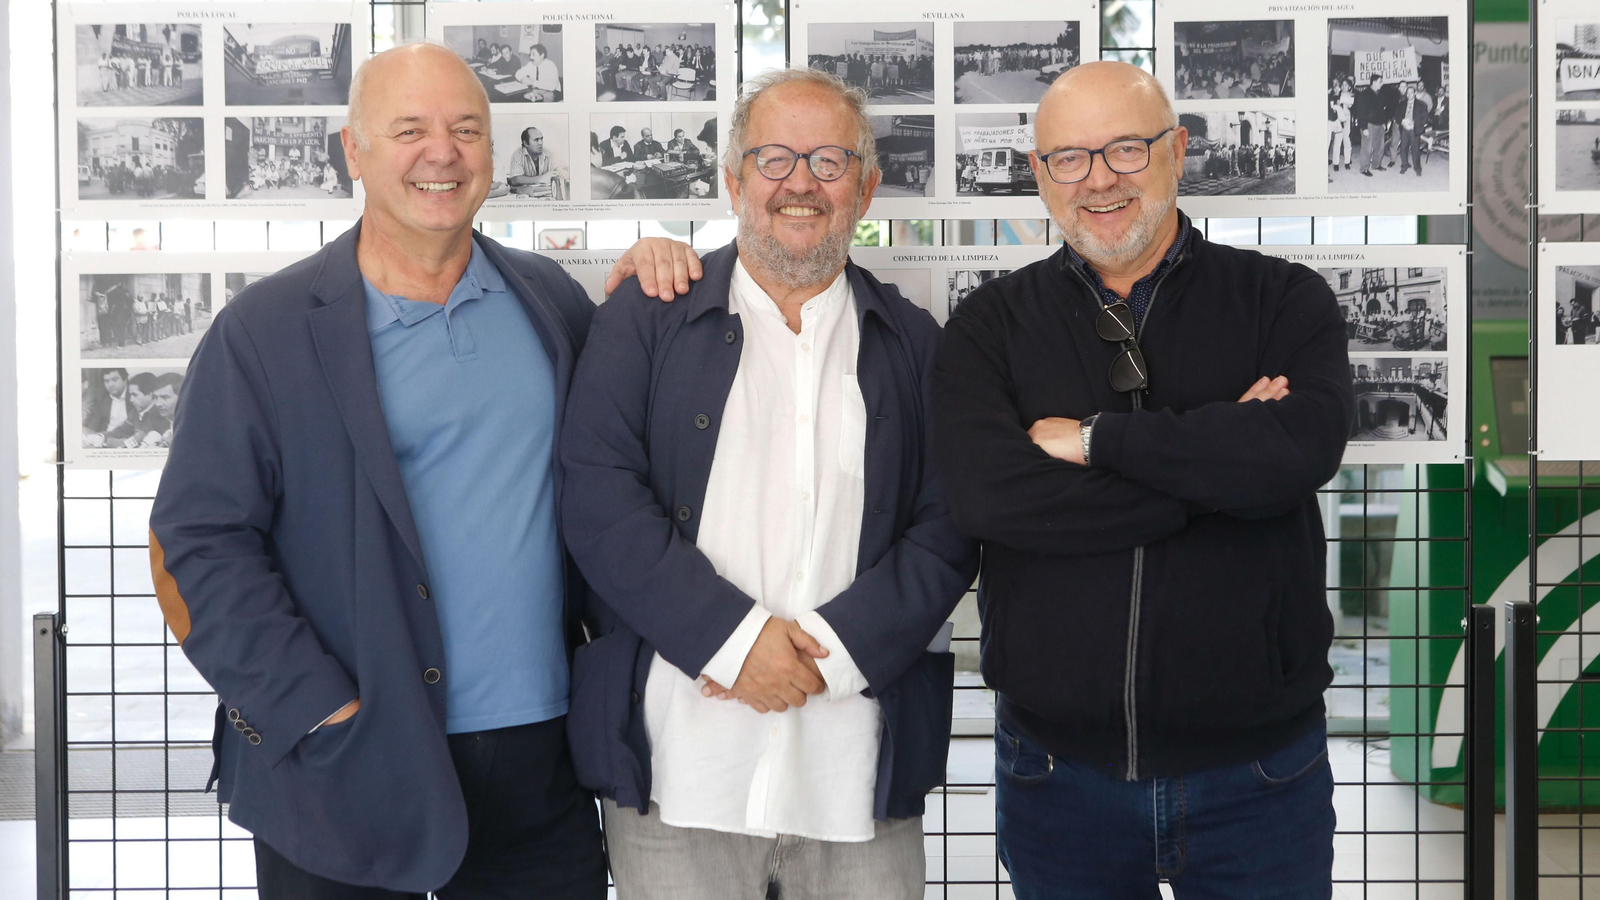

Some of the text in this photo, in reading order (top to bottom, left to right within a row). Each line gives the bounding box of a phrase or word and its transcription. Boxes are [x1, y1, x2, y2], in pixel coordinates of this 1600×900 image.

[1268, 4, 1320, 12] PRIVATIZACIÓN
[542, 13, 574, 21] POLICÍA
[1366, 50, 1405, 62] QUE NO
[1475, 41, 1530, 64] Punto
[1360, 60, 1407, 71] NEGOCIEN
